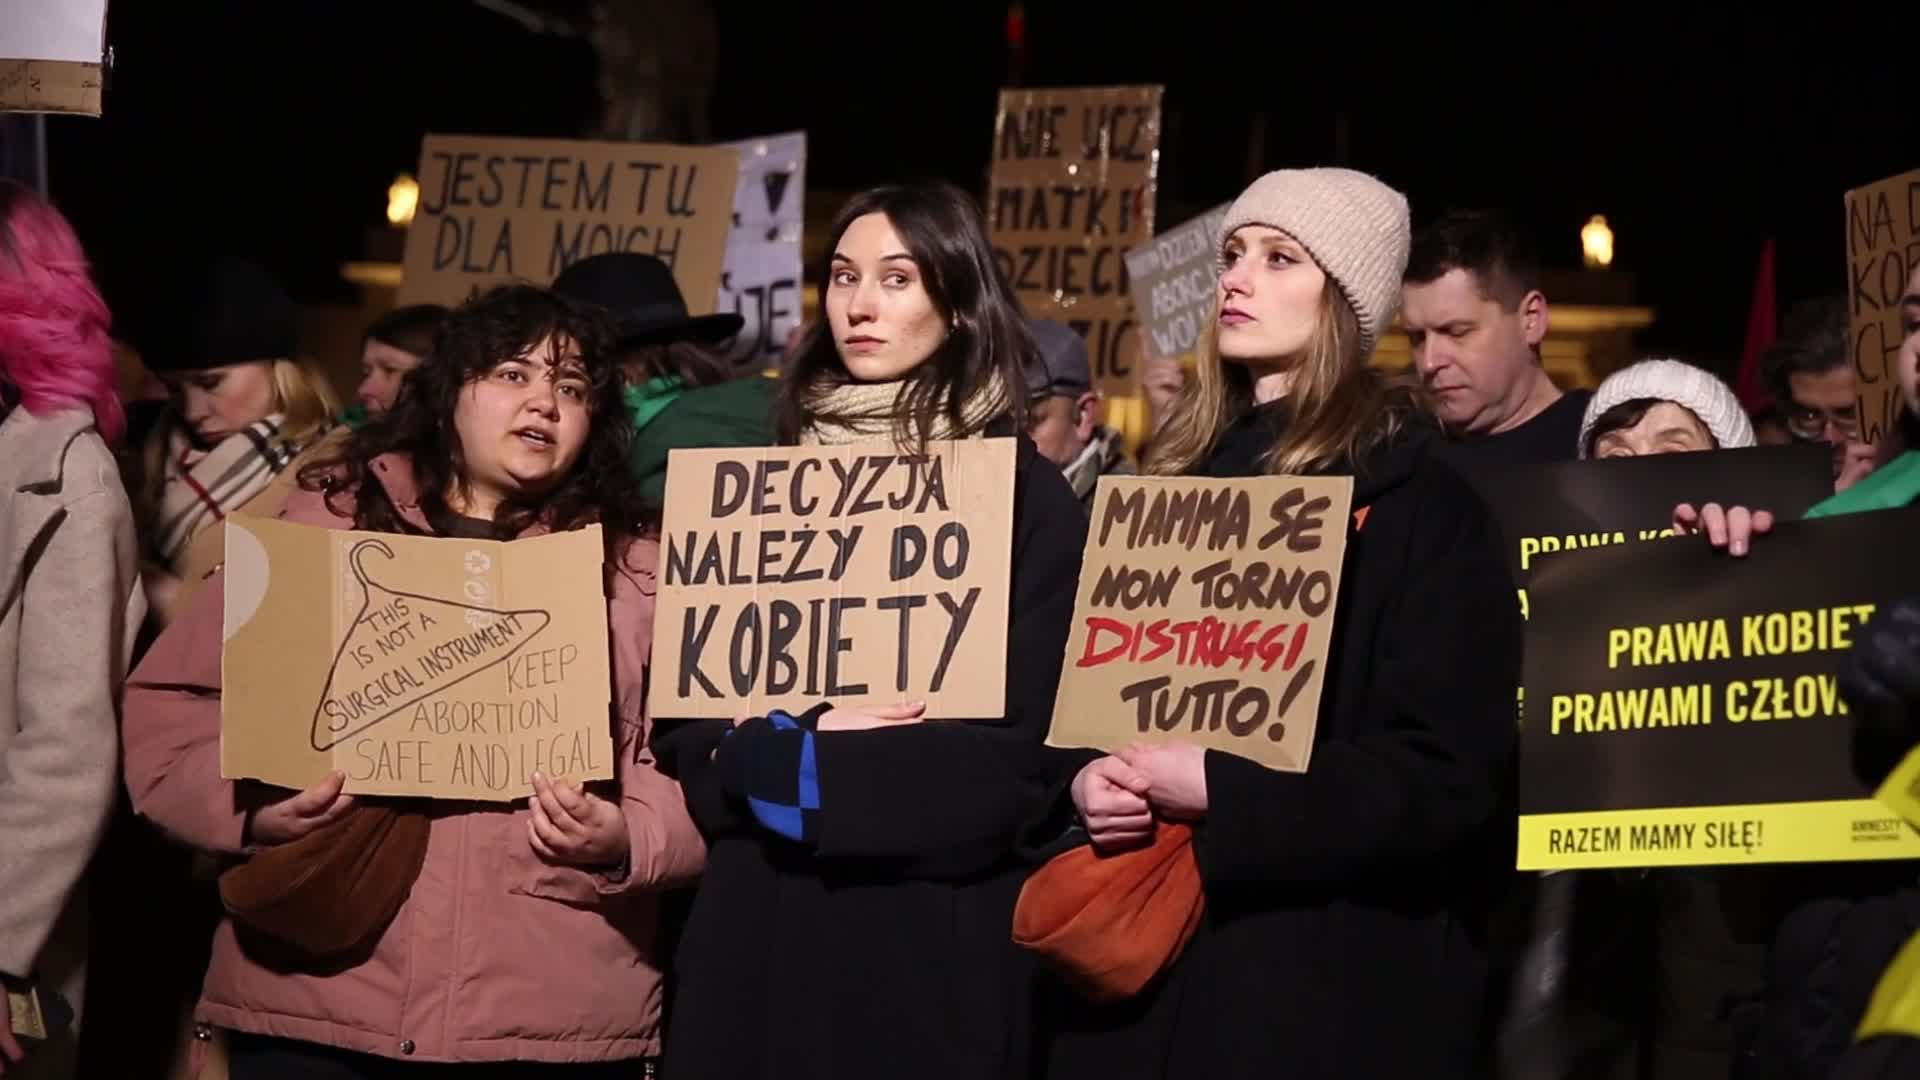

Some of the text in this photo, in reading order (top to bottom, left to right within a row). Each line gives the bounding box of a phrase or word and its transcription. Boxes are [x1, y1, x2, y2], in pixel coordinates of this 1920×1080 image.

[1000, 104, 1150, 161] NIE UCZ
[424, 152, 697, 217] JESTEM TU
[432, 215, 514, 274] DLA
[711, 454, 950, 518] DECYZJA
[1098, 486, 1332, 553] MAMMA SE
[665, 521, 970, 586] NALEŻY DO
[359, 598, 412, 633] THIS
[1090, 558, 1333, 618] NON TORNO
[351, 612, 438, 671] IS NOT A
[677, 587, 982, 698] KOBIETY
[1076, 615, 1309, 673] DISTRUGGI
[1608, 604, 1876, 669] PRAWA KOBIET
[323, 612, 525, 733] SURGICAL INSTRUMENT
[504, 643, 579, 695] KEEP
[408, 693, 560, 736] ABORTION
[1119, 659, 1316, 743] TUTTO!
[1550, 673, 1849, 736] PRAWAMI CZŁOW
[349, 726, 602, 791] SAFE AND LEGAL
[1549, 819, 1764, 855] RAZEM MAMY SIŁĘ!
